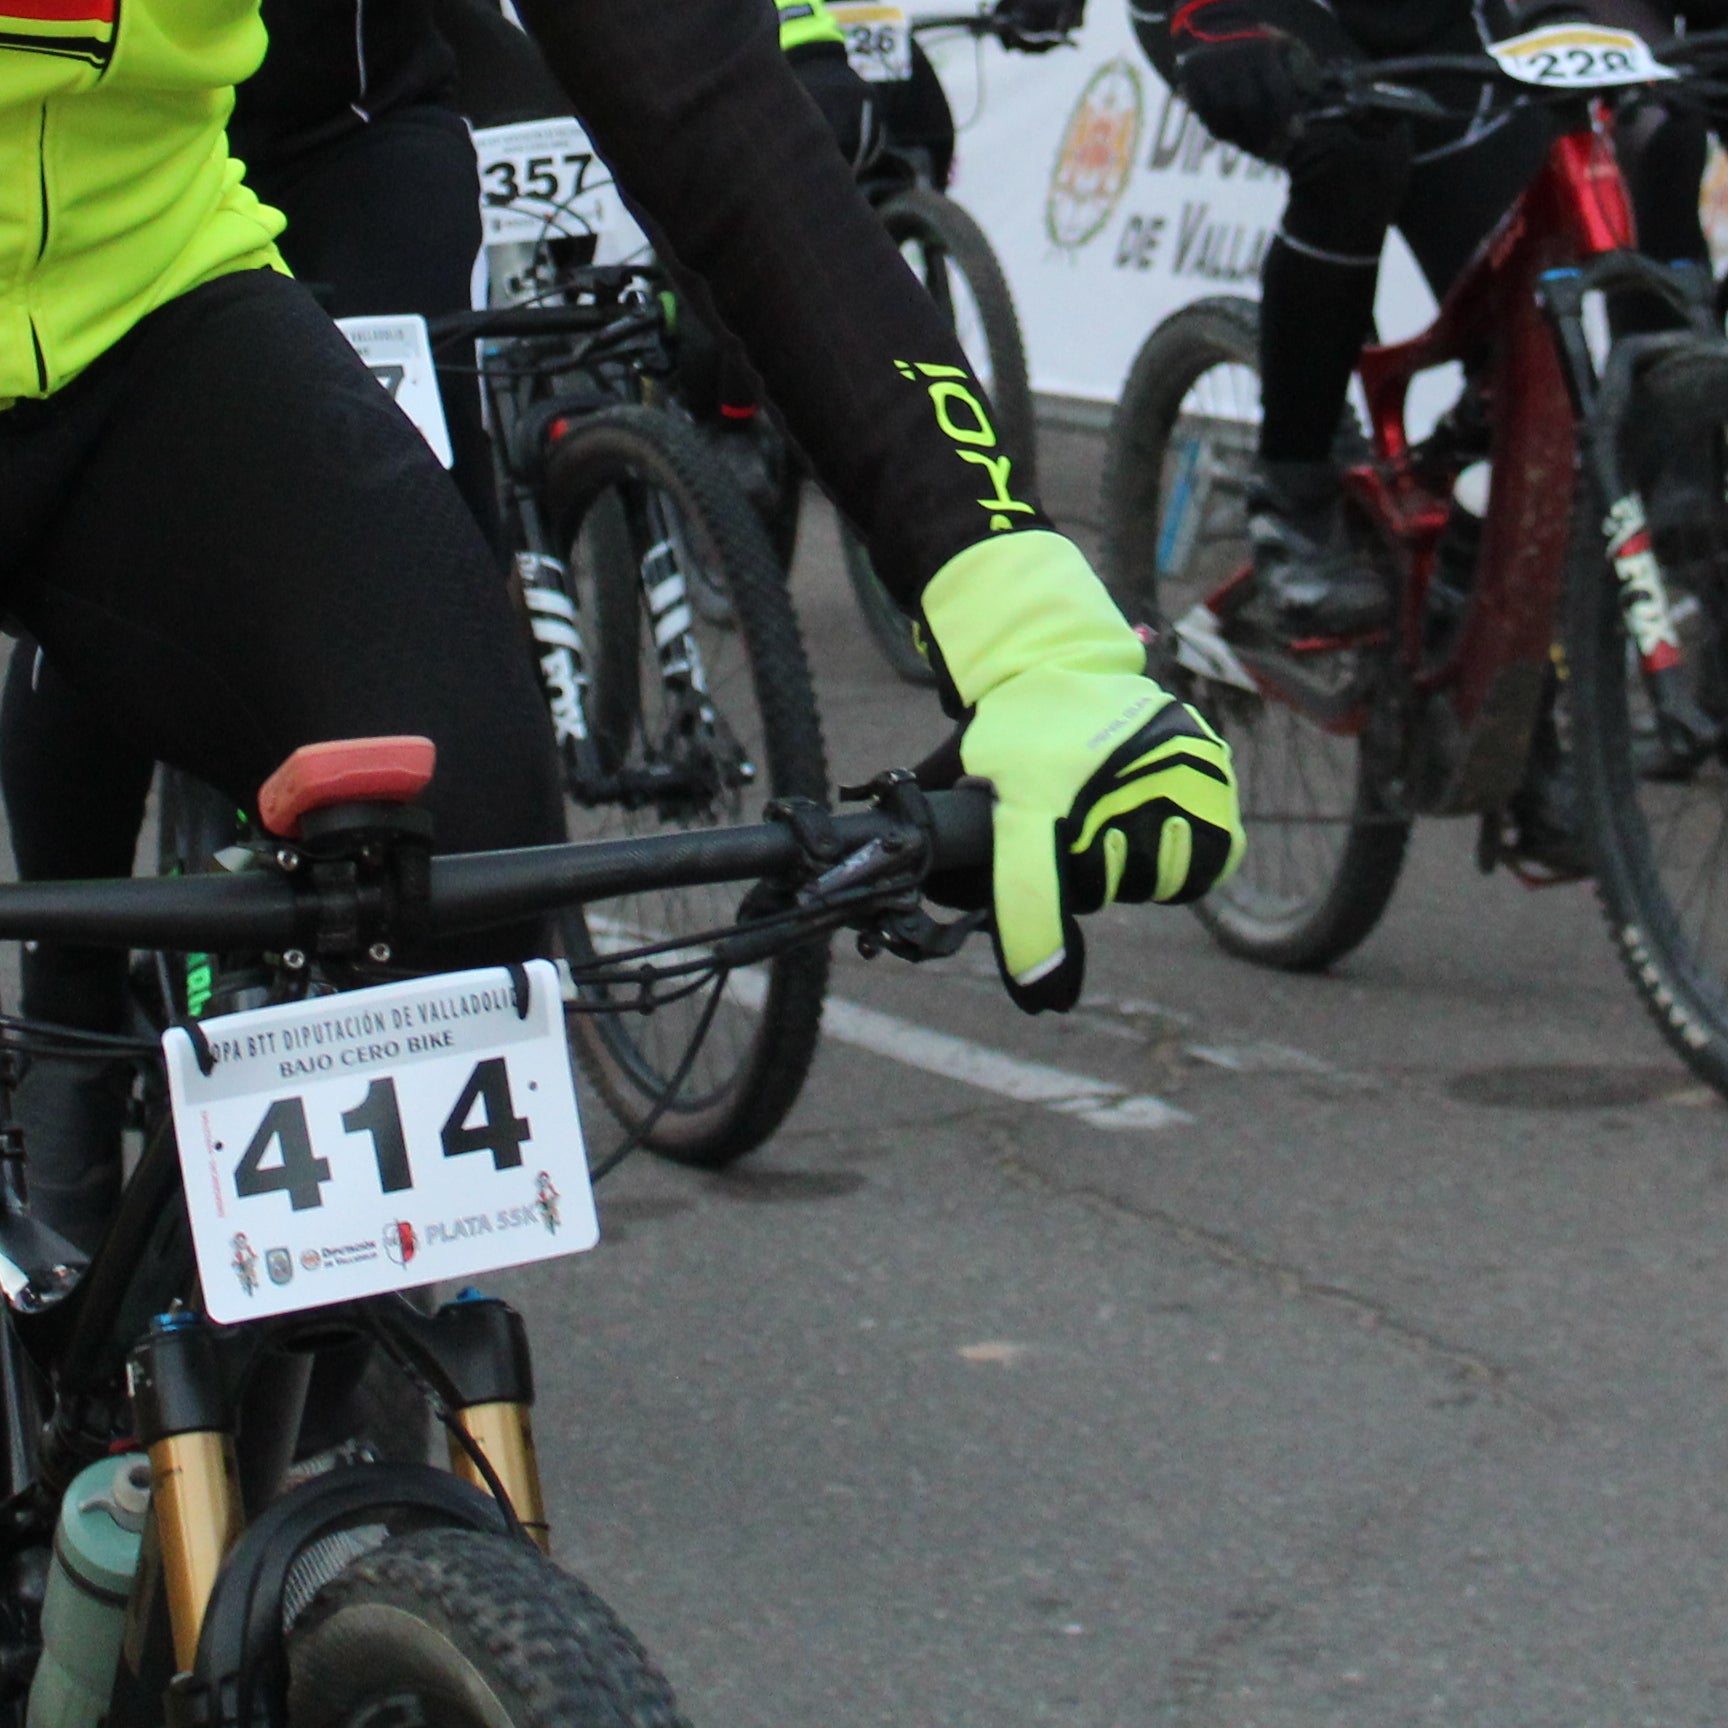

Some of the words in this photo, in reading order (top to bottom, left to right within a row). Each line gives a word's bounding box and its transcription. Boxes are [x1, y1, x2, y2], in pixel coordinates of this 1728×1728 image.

[484, 153, 593, 206] 357
[209, 1040, 243, 1064] OPA
[248, 1031, 277, 1058] BTT
[282, 1010, 387, 1051] DIPUTACIÓN
[392, 1005, 414, 1030] DE
[278, 1053, 334, 1078] BAJO
[340, 1041, 400, 1067] CERO
[407, 1029, 455, 1055] BIKE
[233, 1056, 533, 1212] 414
[425, 1214, 493, 1246] PLATA
